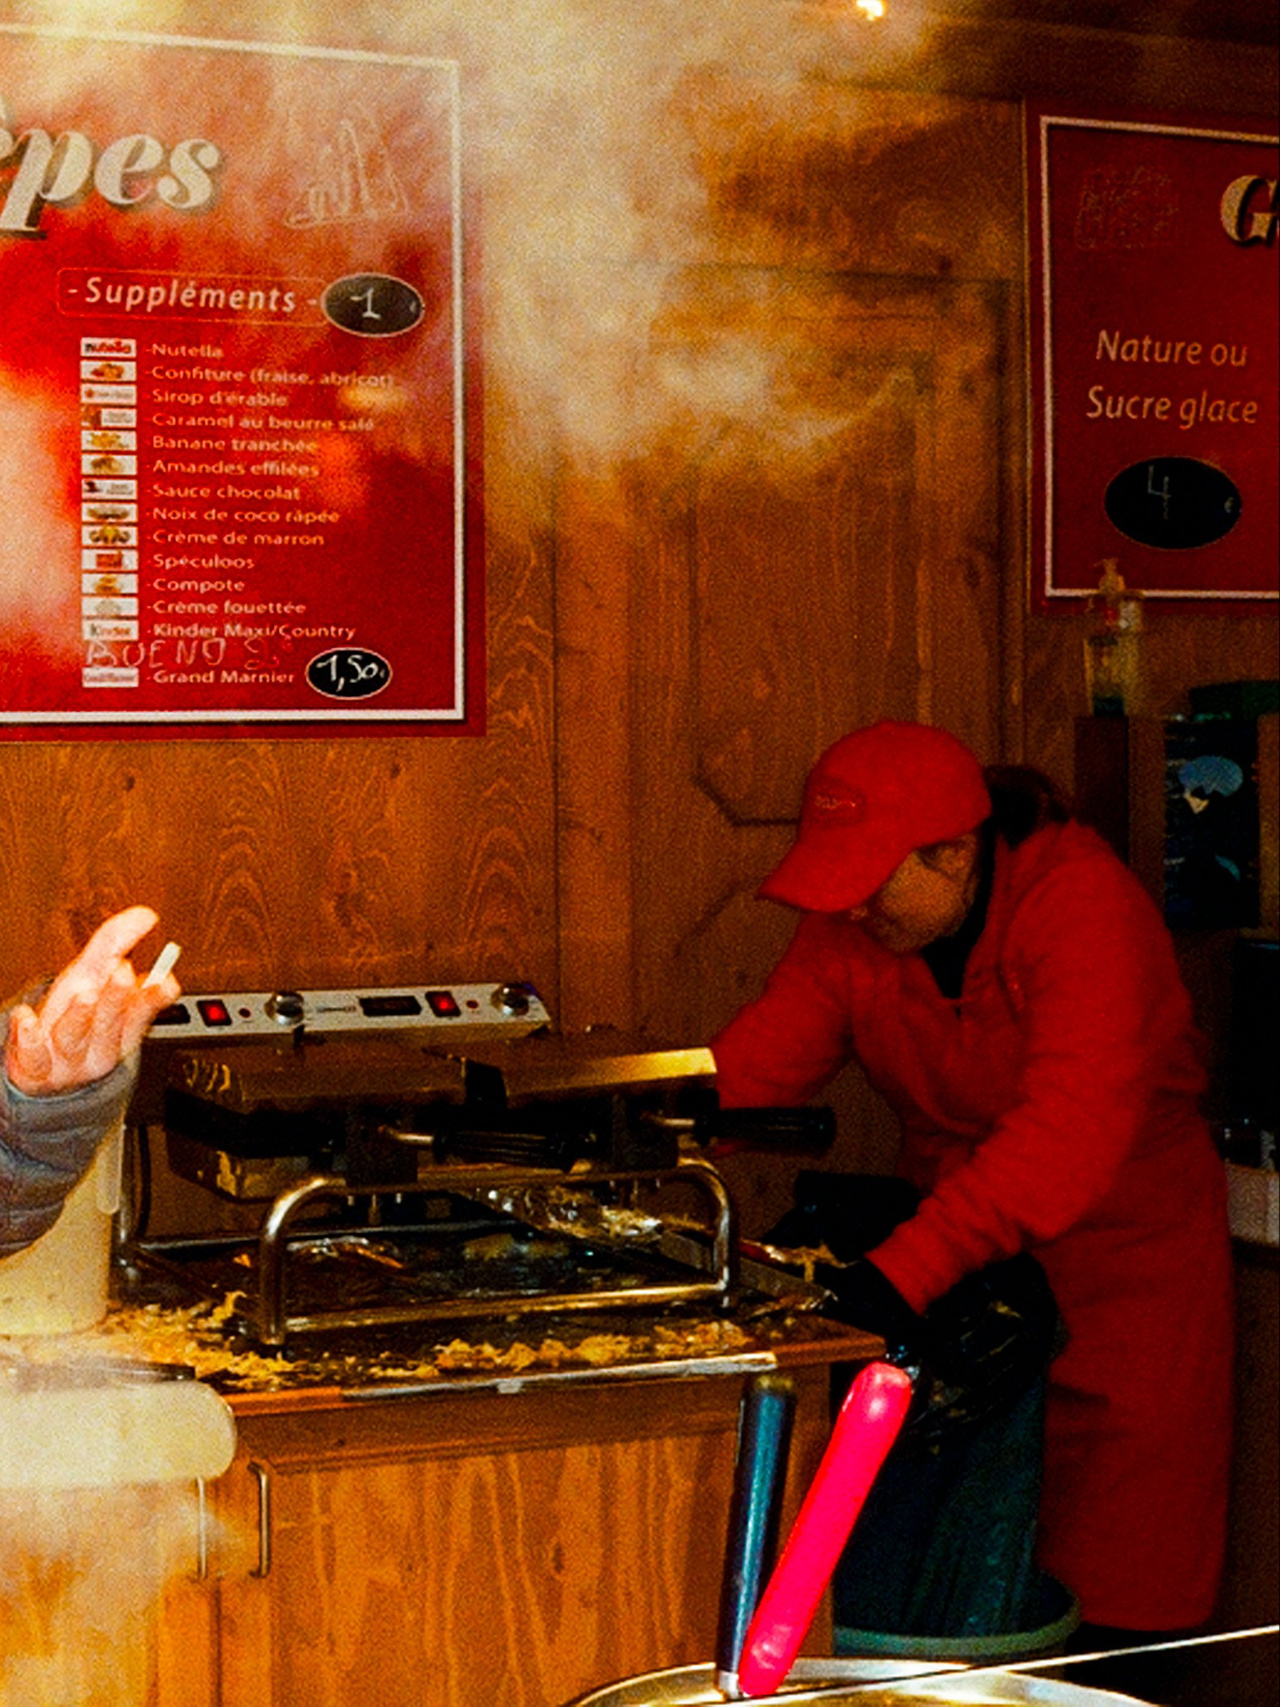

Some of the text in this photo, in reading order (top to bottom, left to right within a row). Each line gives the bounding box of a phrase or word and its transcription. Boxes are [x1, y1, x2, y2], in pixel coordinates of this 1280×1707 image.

[1220, 174, 1279, 245] G
[85, 277, 296, 312] Suppléments
[152, 344, 224, 358] Nutella
[1095, 329, 1248, 366] Nature ou
[152, 366, 394, 388] Confiture (fraise, abricot)
[152, 389, 204, 406] Sirop
[209, 390, 288, 407] d'érable
[1085, 385, 1258, 430] Sucre glace
[152, 413, 375, 431] Caramel au beurre salé
[152, 436, 225, 449] Banane
[152, 459, 319, 476] Amandes effilées
[152, 484, 210, 498] Sauce
[216, 485, 300, 500] chocolat
[1147, 464, 1172, 520] 4
[153, 507, 340, 525] Noix de coco râpée
[153, 529, 325, 546] Crème de marron
[153, 553, 255, 569] Spéculoos
[153, 578, 245, 594] Compote
[153, 600, 307, 614] Crème fouettée
[153, 623, 356, 640] Kinder Maxi/Country
[86, 638, 227, 669] BUENO
[153, 669, 214, 684] Grand
[221, 670, 295, 684] Marnier
